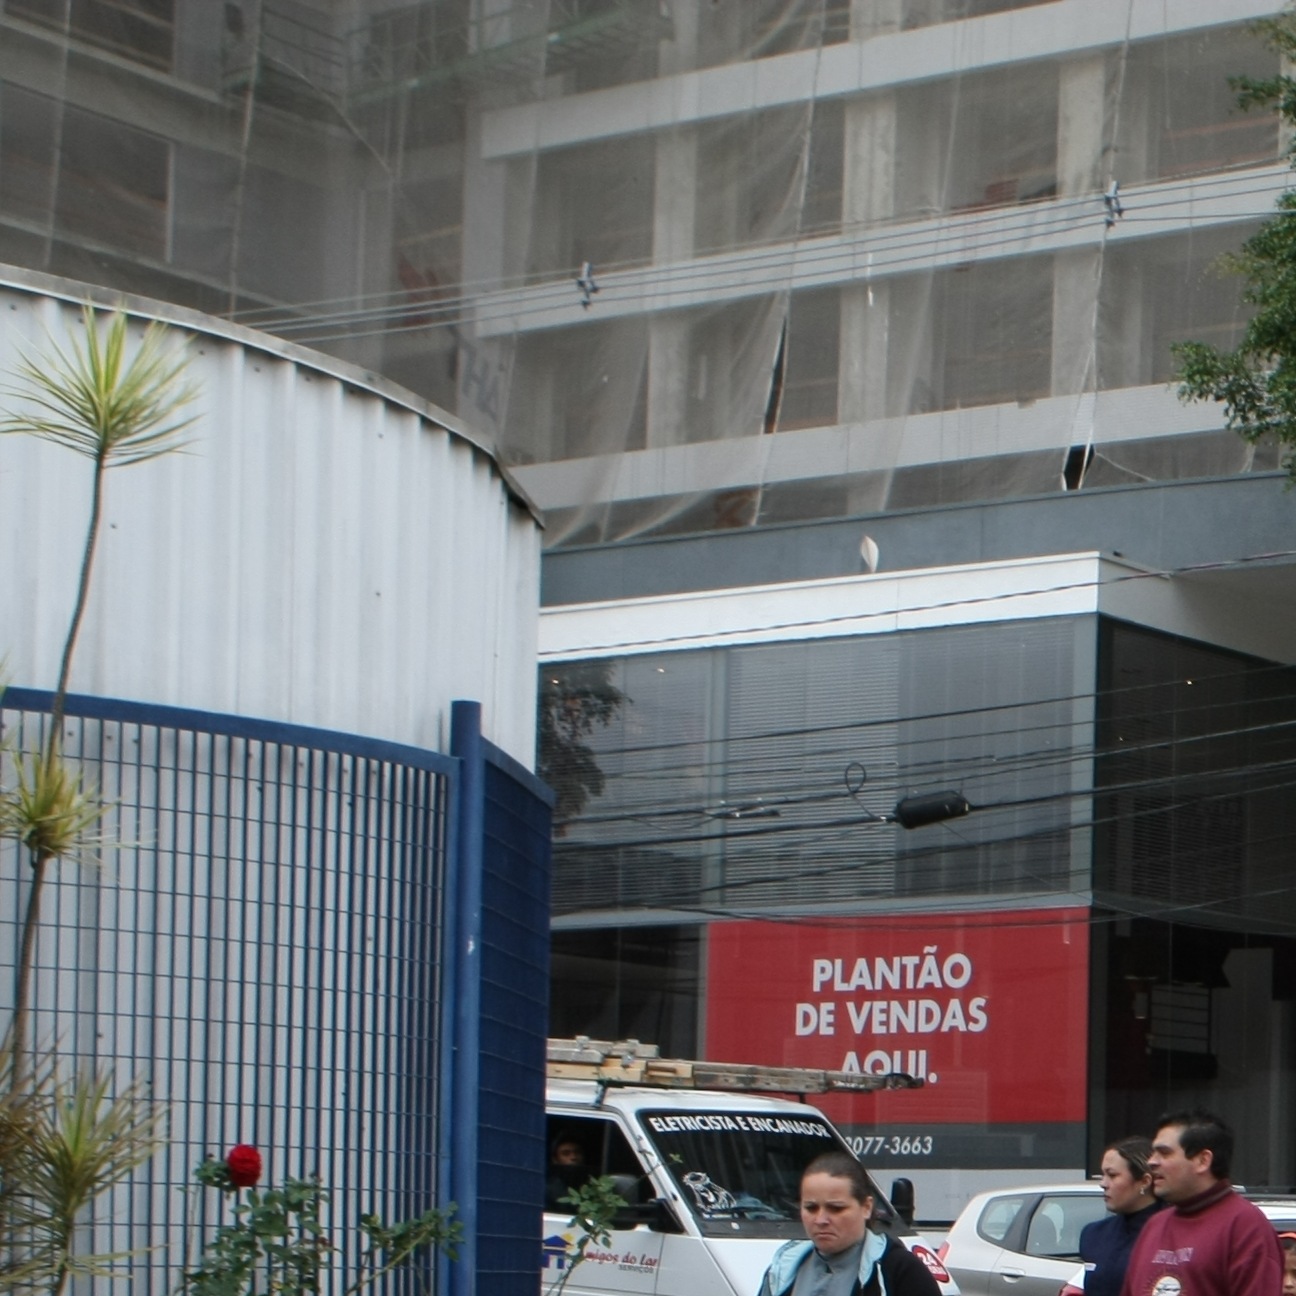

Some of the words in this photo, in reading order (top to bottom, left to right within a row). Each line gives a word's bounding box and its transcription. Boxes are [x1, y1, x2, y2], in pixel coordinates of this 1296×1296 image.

[812, 945, 972, 992] PLANTÃO
[795, 1002, 835, 1036] DE
[846, 997, 988, 1035] VENDAS
[842, 1049, 938, 1084] AQUI.
[649, 1115, 737, 1132] ELETRICISTA
[735, 1116, 749, 1131] E
[747, 1116, 832, 1138] ENCANADOR
[585, 1249, 619, 1264] migos
[621, 1251, 637, 1265] do
